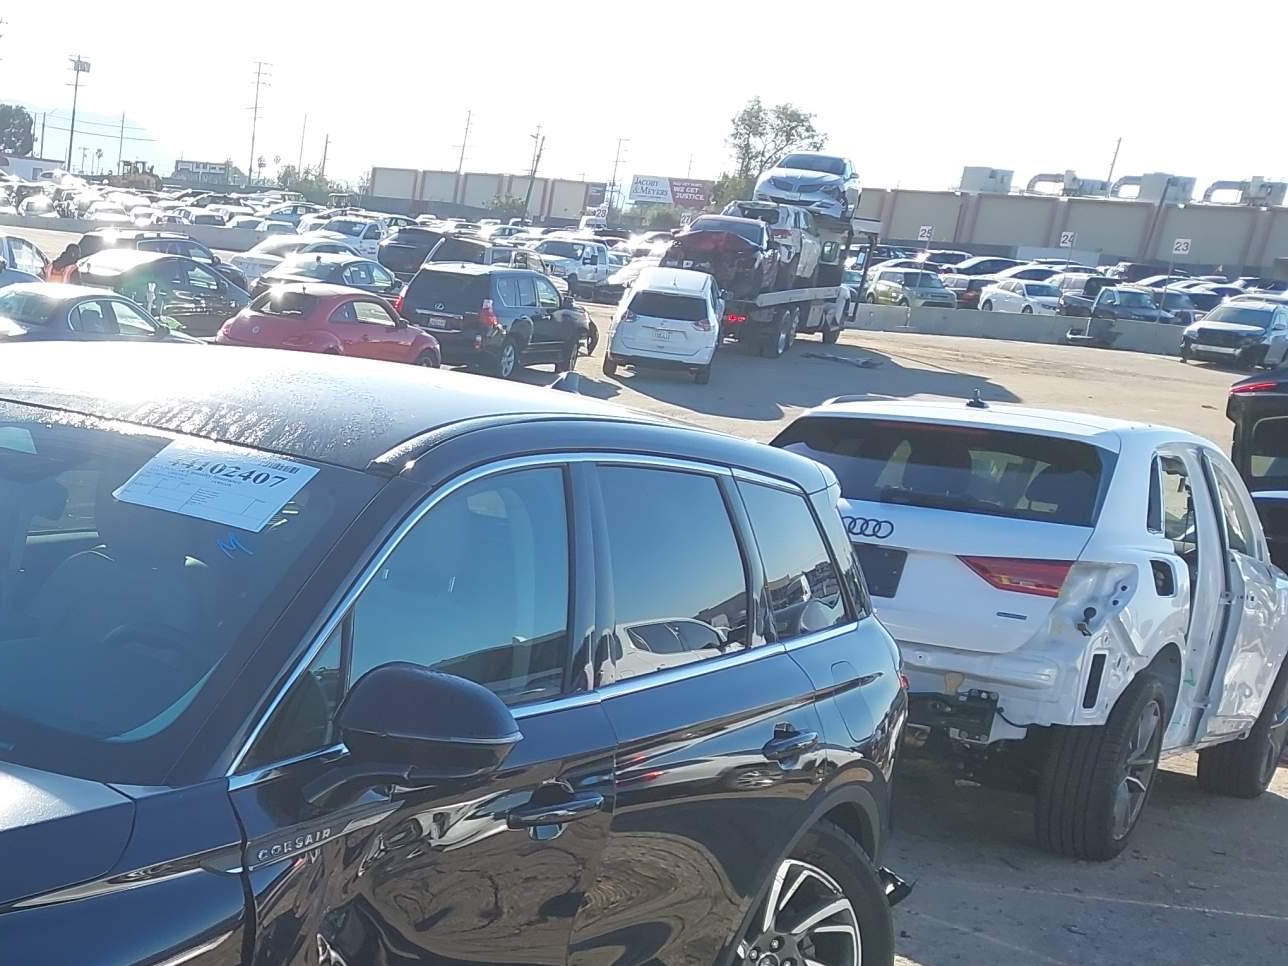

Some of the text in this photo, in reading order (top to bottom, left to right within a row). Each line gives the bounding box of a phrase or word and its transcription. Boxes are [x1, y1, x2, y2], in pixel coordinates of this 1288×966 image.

[920, 229, 933, 239] 25
[1174, 242, 1190, 252] 23
[258, 829, 331, 861] CORSAIR
